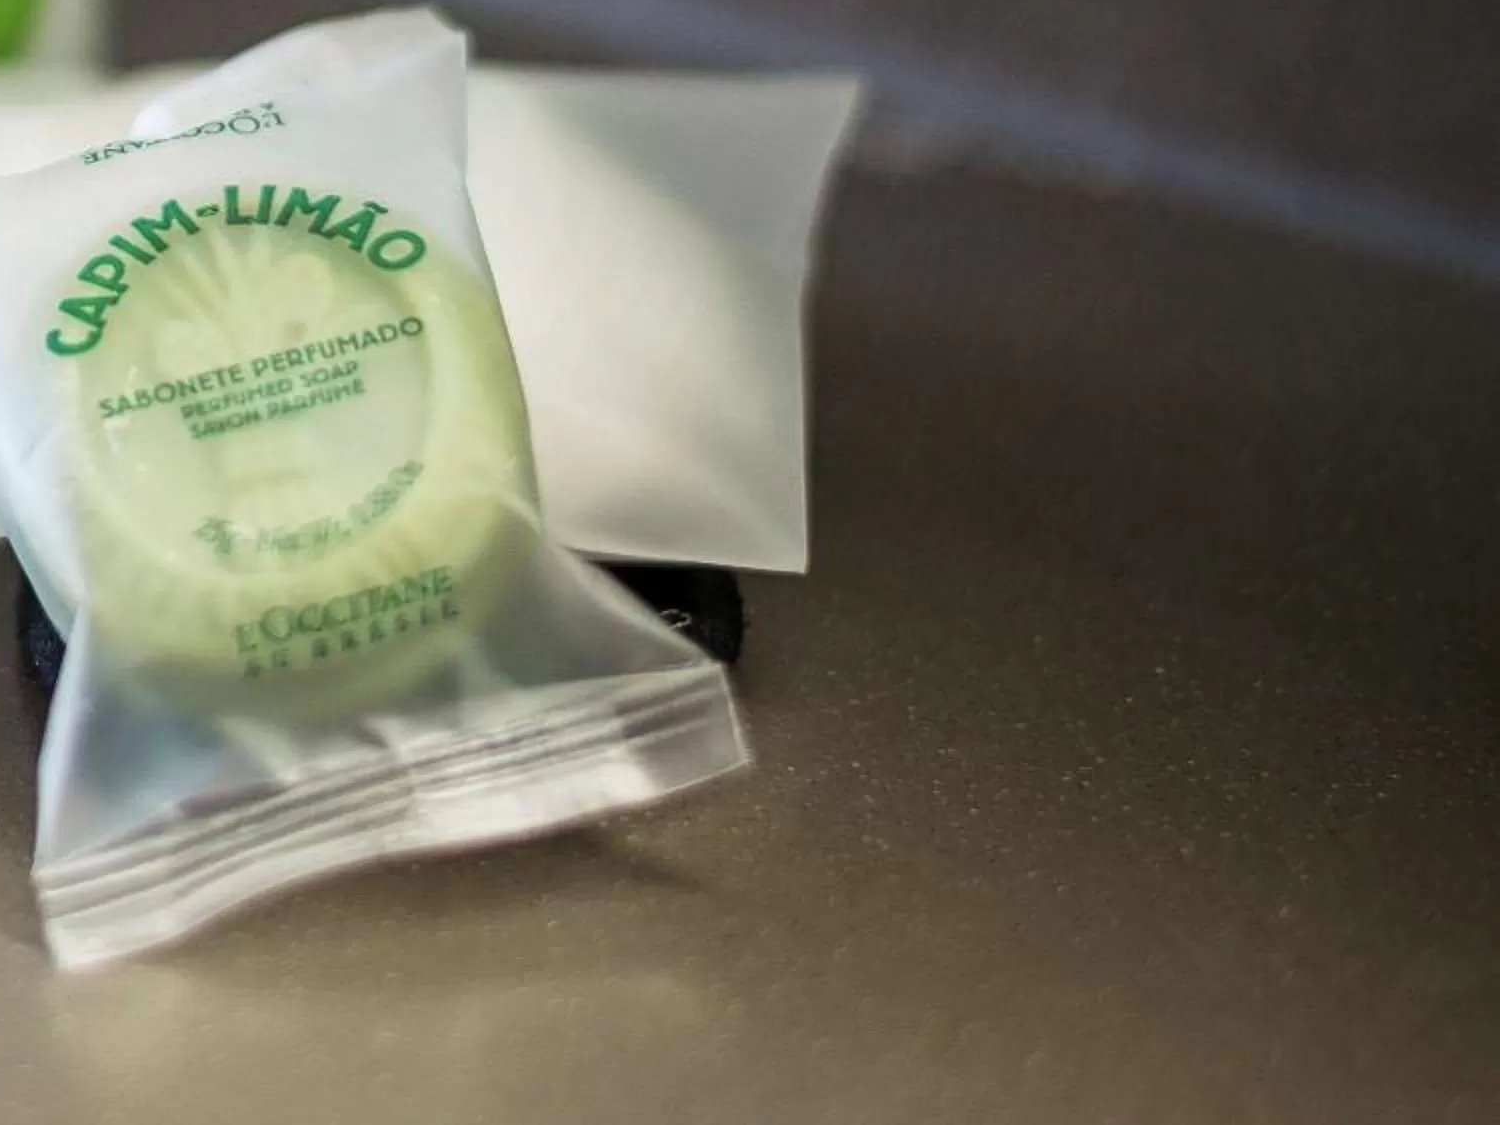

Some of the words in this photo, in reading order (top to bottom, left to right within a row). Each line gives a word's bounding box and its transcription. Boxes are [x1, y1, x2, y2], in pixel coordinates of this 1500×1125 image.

[46, 184, 427, 357] CAPIM-LIMÃO
[98, 363, 246, 419] SABONETE
[250, 316, 425, 378] PERFUMADO
[180, 378, 293, 421] PERFUMED
[300, 359, 359, 389] SOAP
